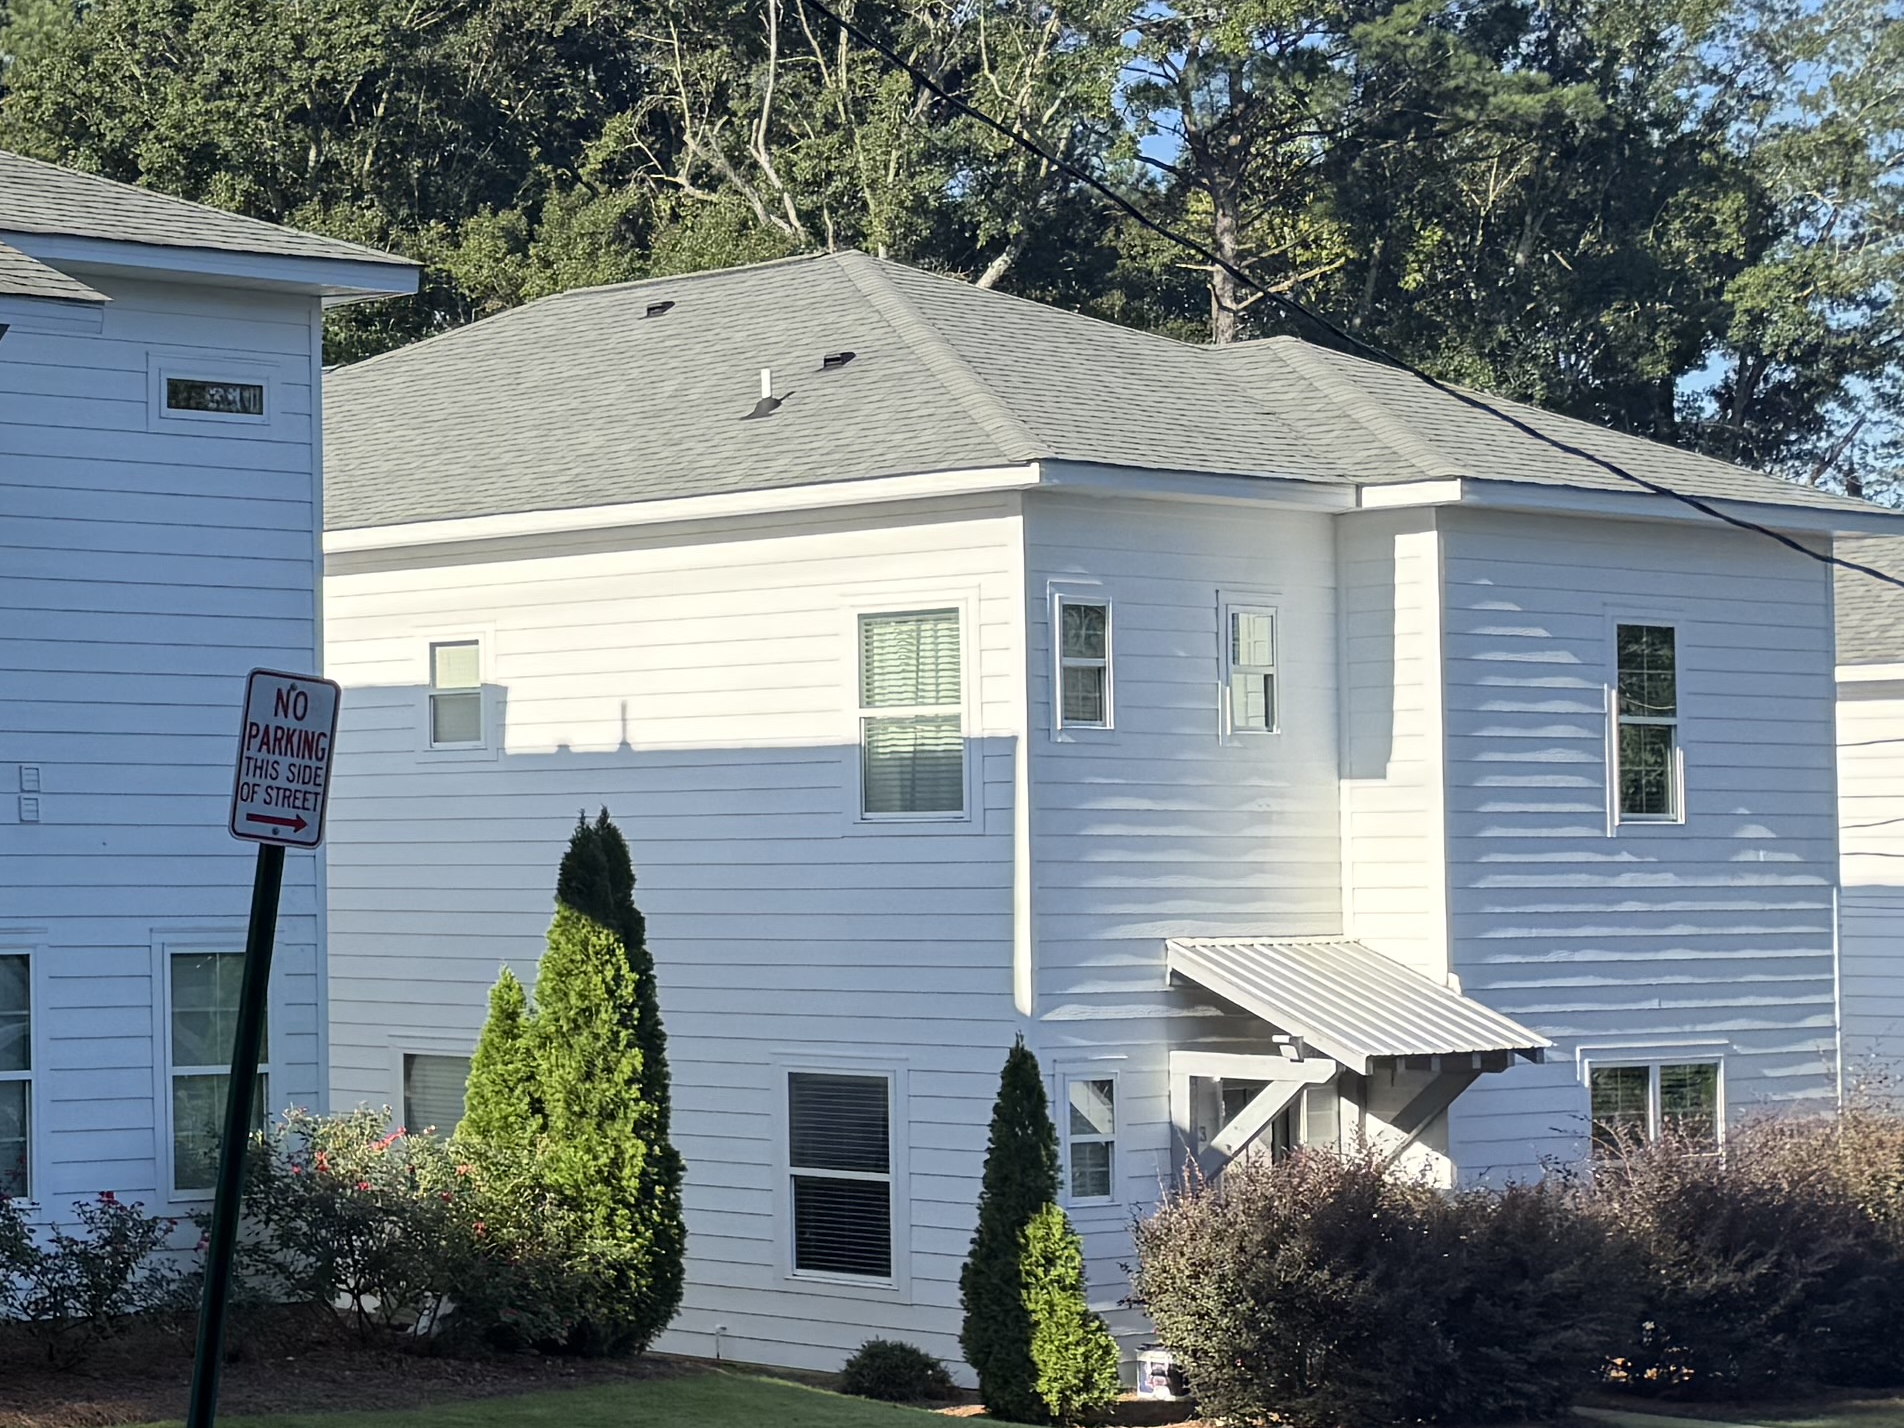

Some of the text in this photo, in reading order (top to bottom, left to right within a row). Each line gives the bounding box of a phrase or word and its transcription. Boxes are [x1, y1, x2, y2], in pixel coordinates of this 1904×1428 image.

[274, 687, 308, 722] NO
[246, 721, 328, 762] PARKING
[244, 755, 323, 787] THIS SIDE
[240, 781, 321, 812] OF STREET
